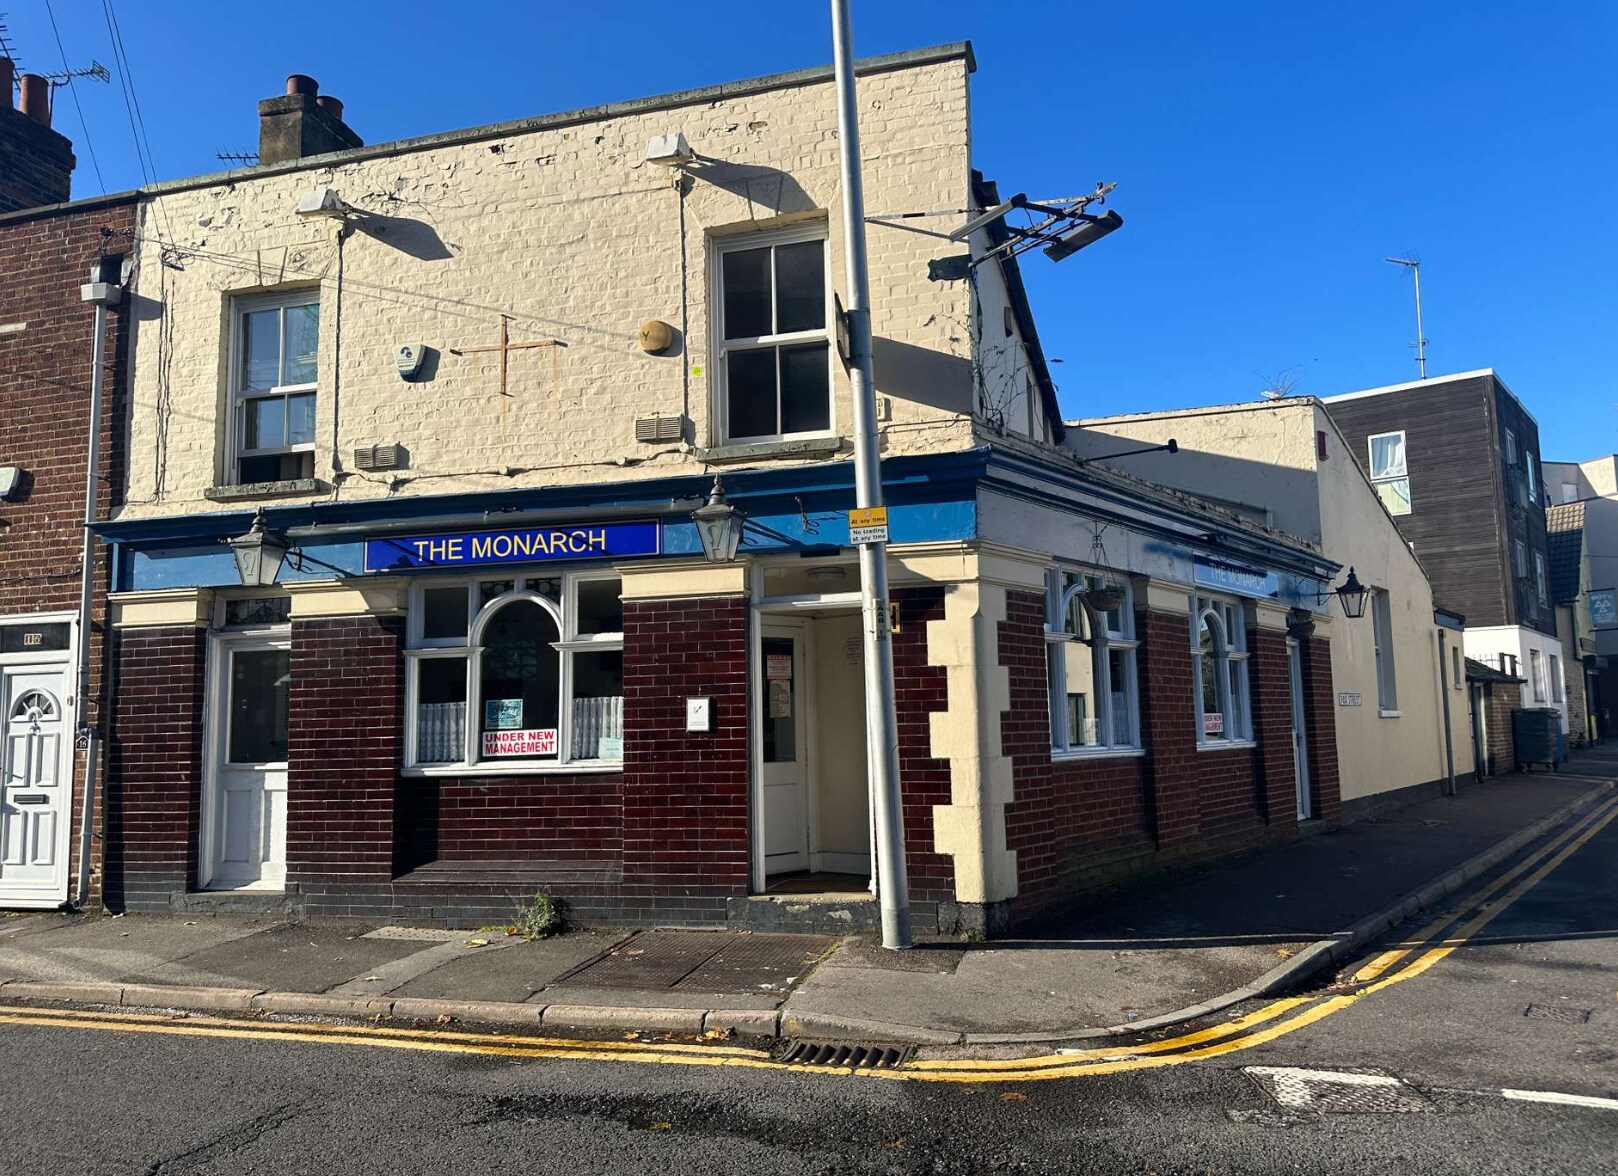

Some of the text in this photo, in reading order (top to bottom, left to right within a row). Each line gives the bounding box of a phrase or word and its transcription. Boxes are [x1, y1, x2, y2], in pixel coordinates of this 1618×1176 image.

[413, 529, 606, 562] THE MONARCH
[1208, 562, 1266, 591] THE MONARCH
[79, 740, 87, 748] 16
[485, 731, 554, 743] UNDER NEW
[485, 741, 554, 755] MANAGEMENT
